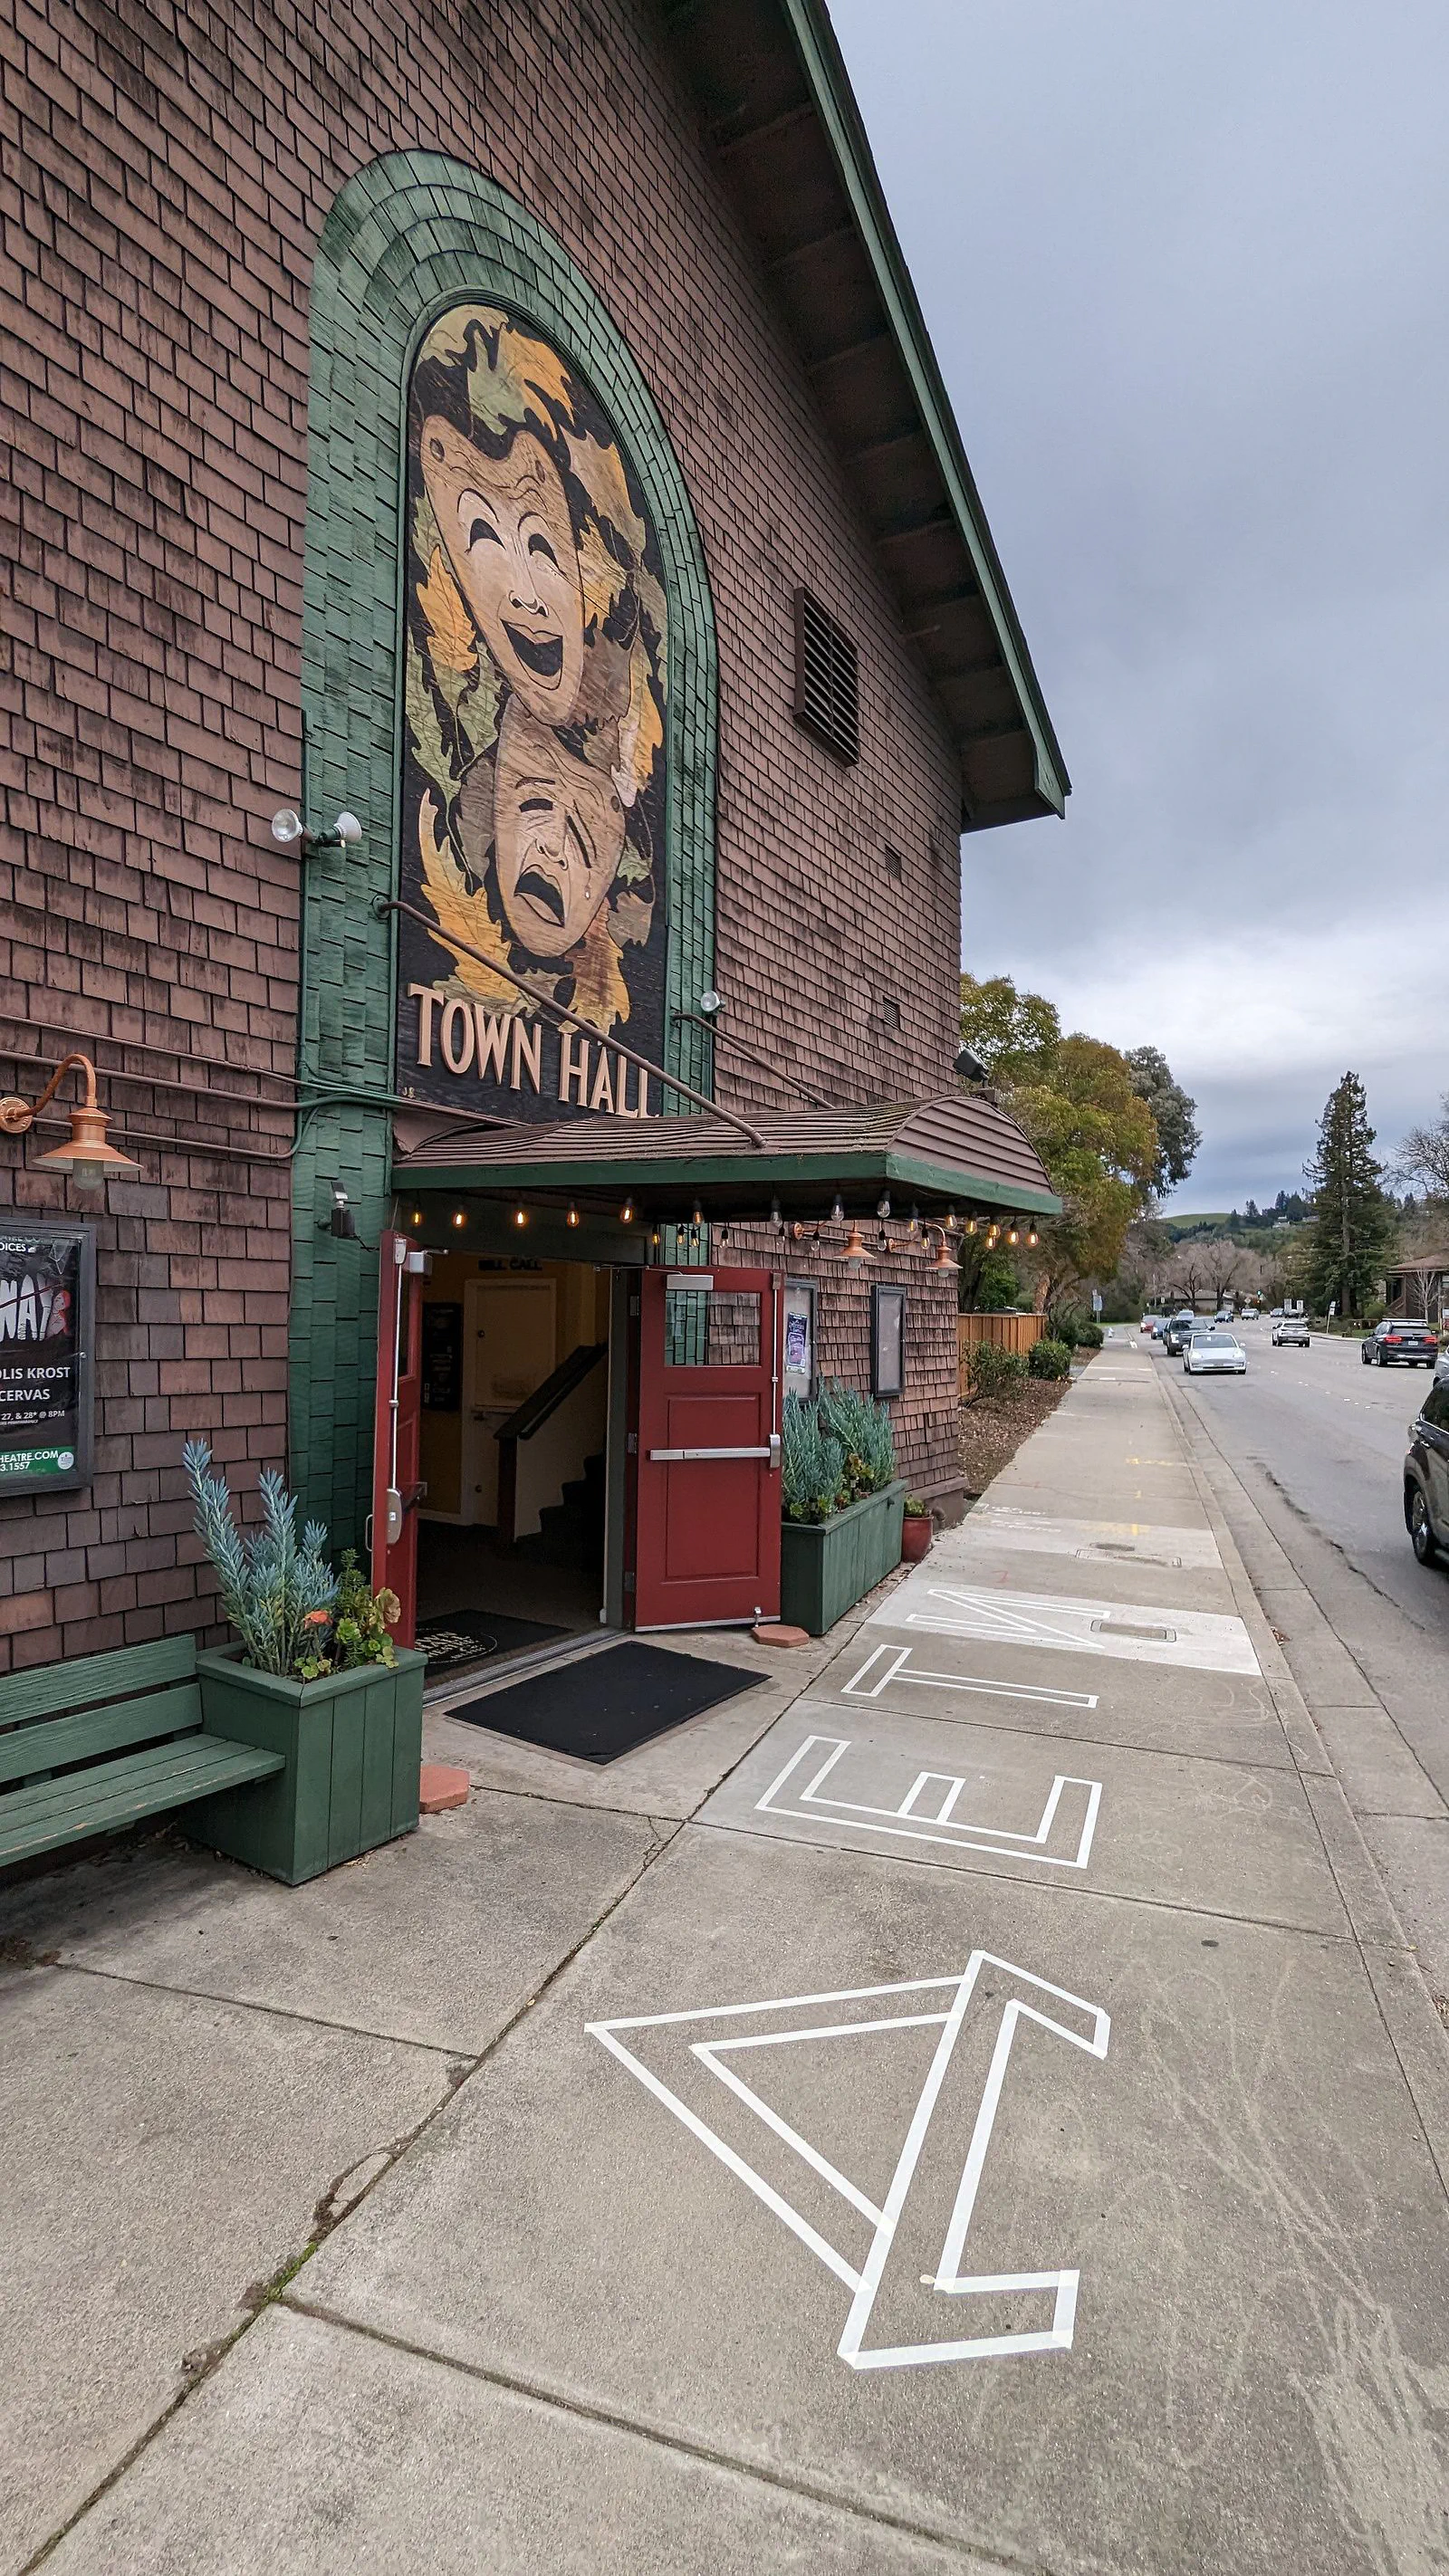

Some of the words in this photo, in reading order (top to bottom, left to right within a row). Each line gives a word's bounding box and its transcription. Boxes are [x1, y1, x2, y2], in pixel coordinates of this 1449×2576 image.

[407, 982, 542, 1094] TOWN
[557, 1030, 660, 1118] HALL
[510, 1258, 542, 1270] CALL
[0, 1368, 24, 1380] LIS
[27, 1366, 71, 1379] KROST
[0, 1389, 51, 1402] CERVAS
[48, 1410, 65, 1418] 8PM
[584, 1587, 1111, 2370] ДЕТИ
